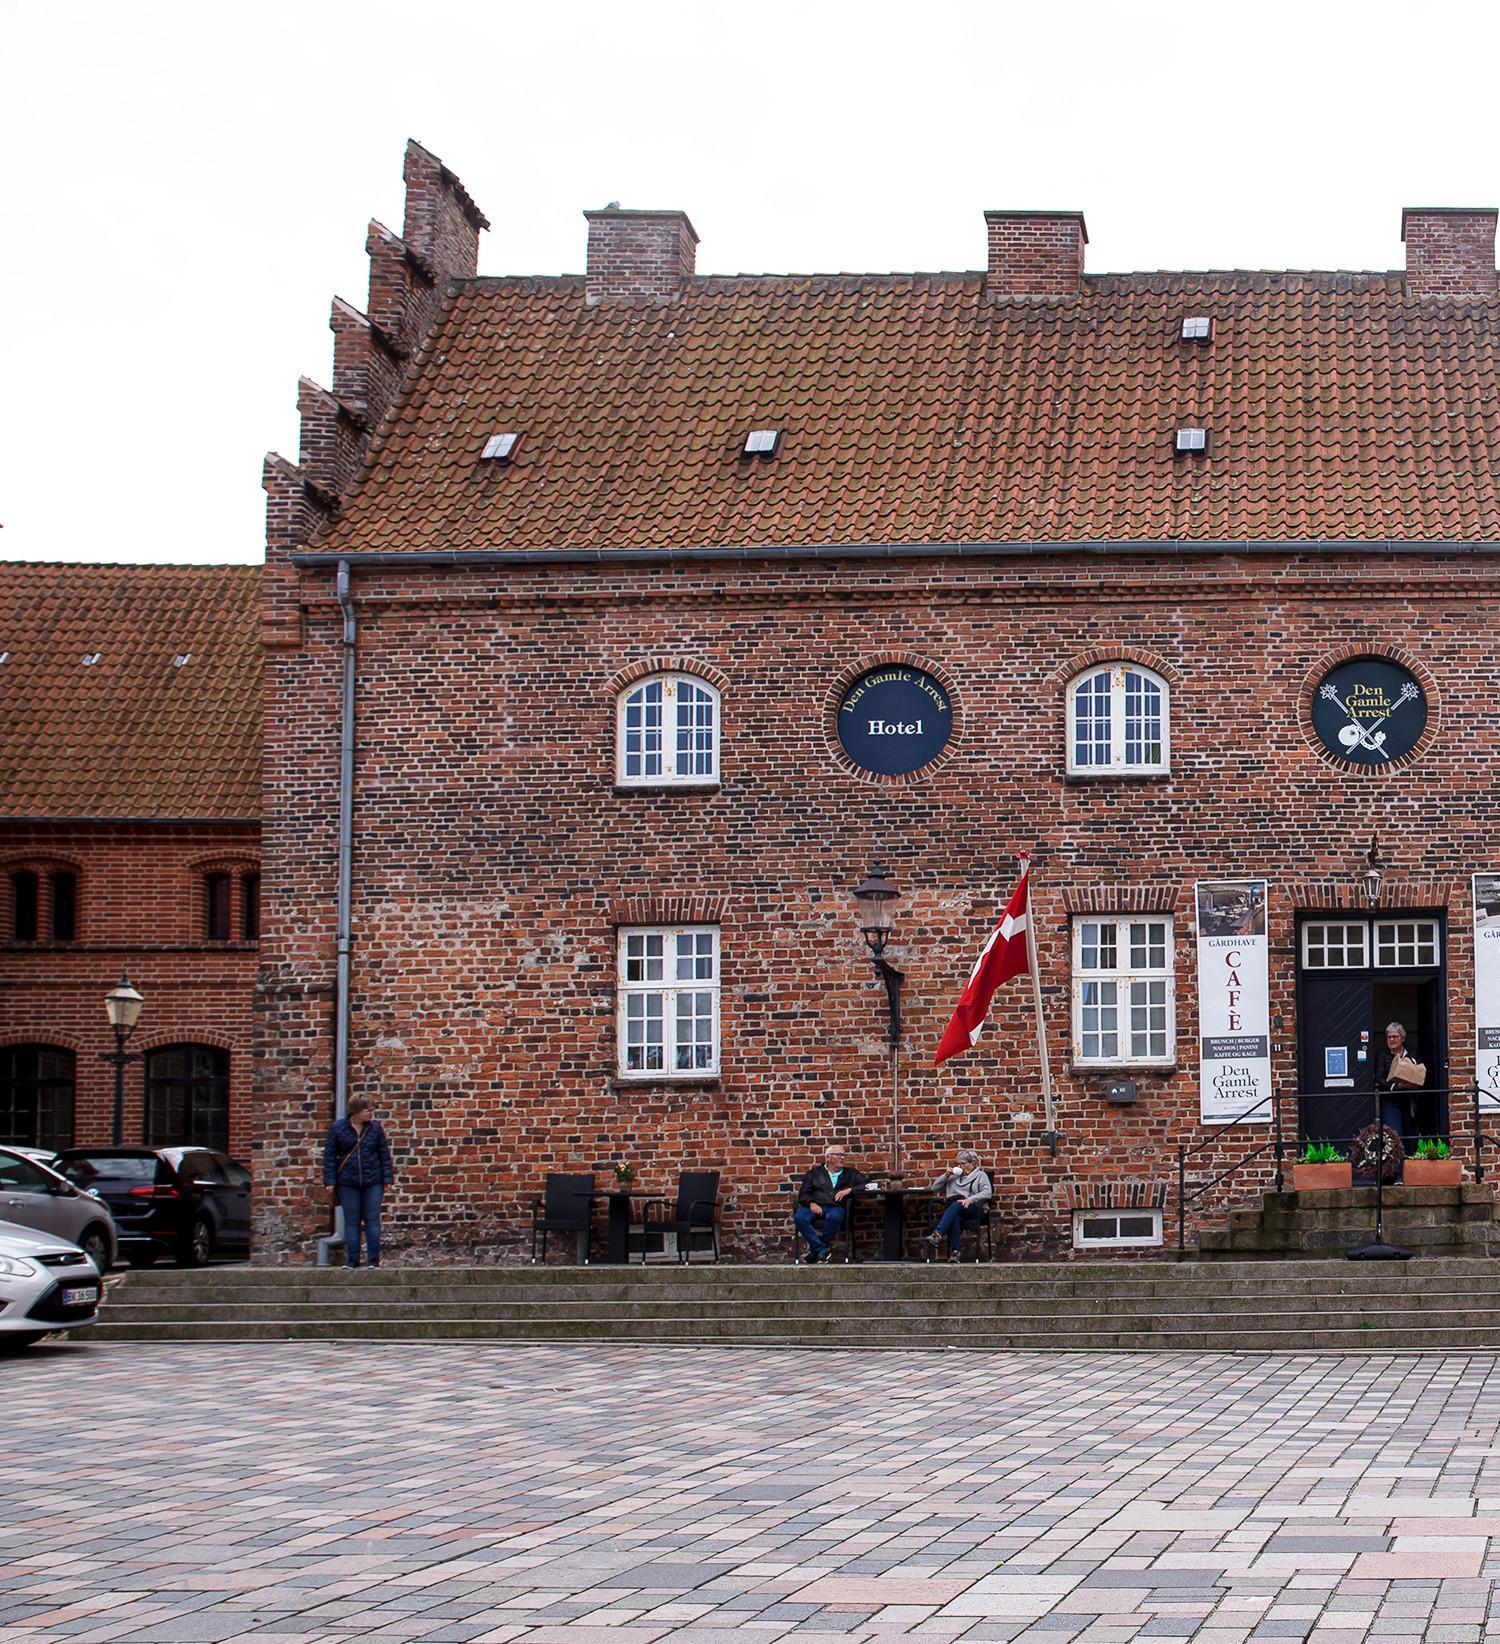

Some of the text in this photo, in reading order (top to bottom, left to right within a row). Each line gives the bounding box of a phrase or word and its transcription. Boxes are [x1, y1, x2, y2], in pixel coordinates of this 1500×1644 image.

[842, 670, 949, 714] Den Gamle Arrest
[1353, 684, 1383, 696] Den
[1345, 695, 1391, 707] Gamle
[1346, 707, 1392, 718] Arrest
[868, 720, 923, 735] Hotel
[1208, 938, 1258, 948] GÅRDHAVE
[1222, 1065, 1249, 1076] Den
[1212, 1075, 1259, 1088] Gamle
[1214, 1087, 1258, 1099] Arrest
